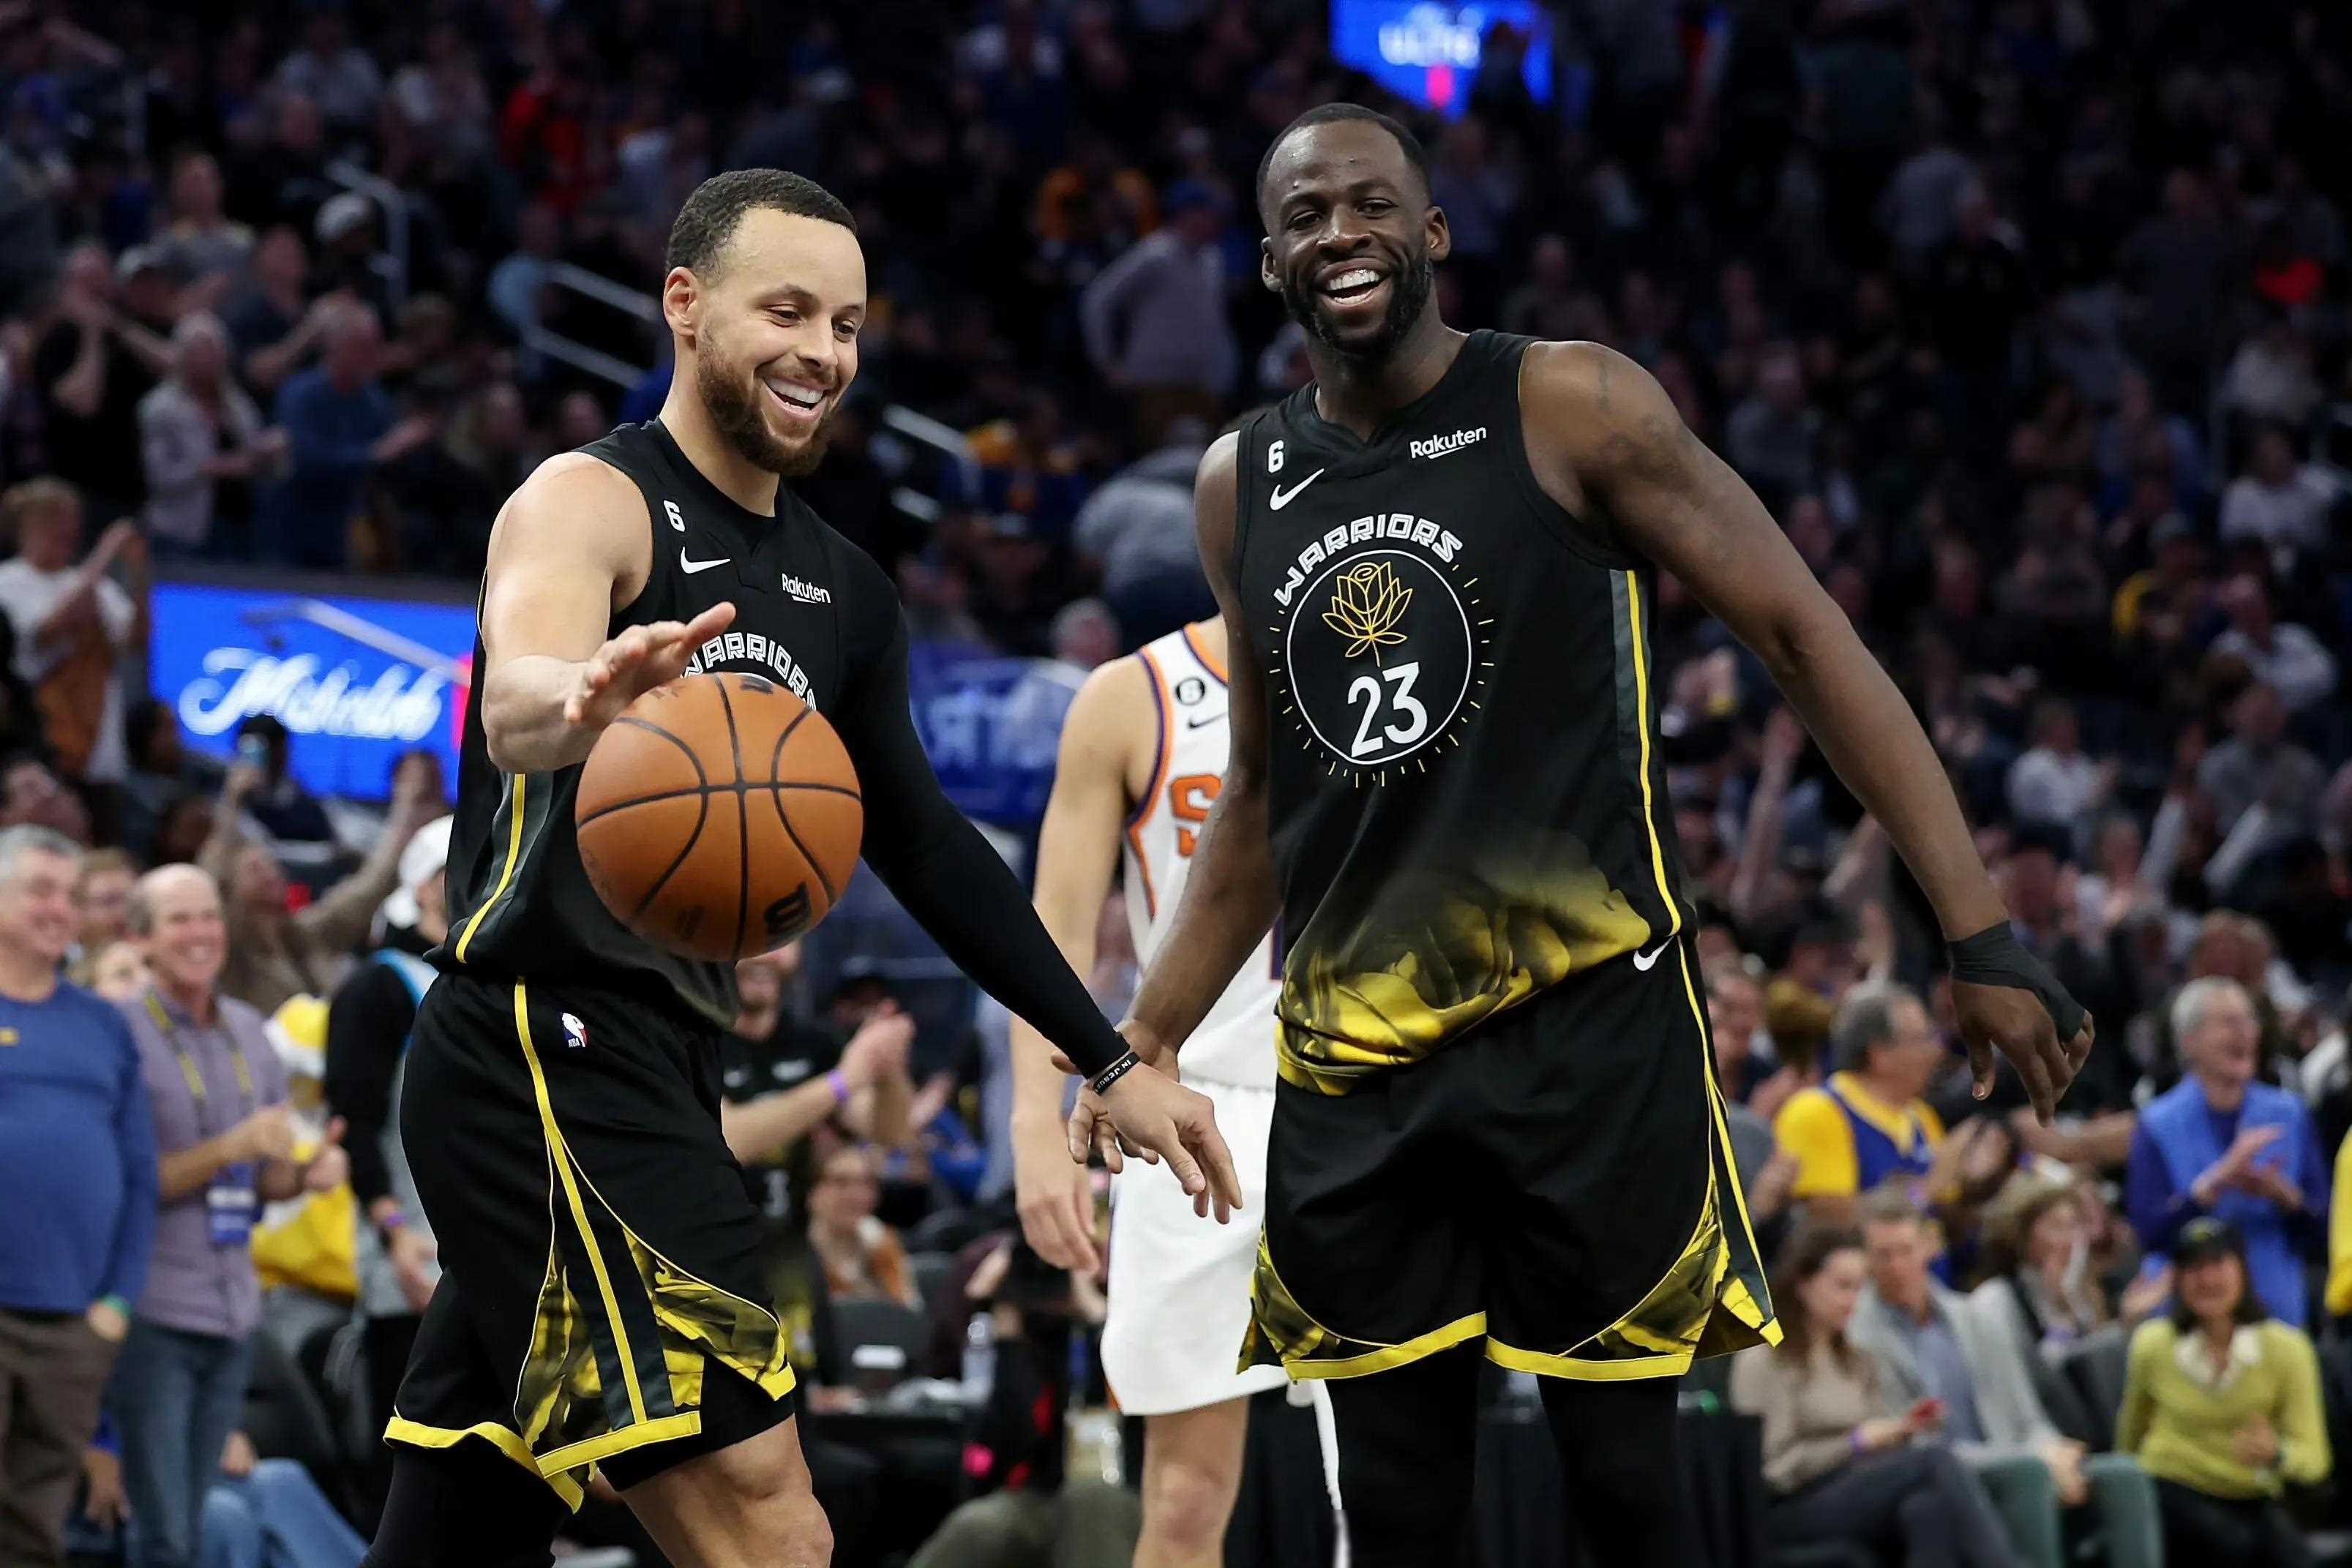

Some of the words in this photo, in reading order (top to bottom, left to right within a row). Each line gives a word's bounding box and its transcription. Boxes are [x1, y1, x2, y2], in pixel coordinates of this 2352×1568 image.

[1267, 439, 1284, 474] 6
[1409, 427, 1488, 459] Rakuten
[663, 500, 686, 532] 6
[1273, 513, 1464, 607] WARRIORS
[781, 573, 832, 604] Rakuten
[1347, 661, 1428, 758] 23
